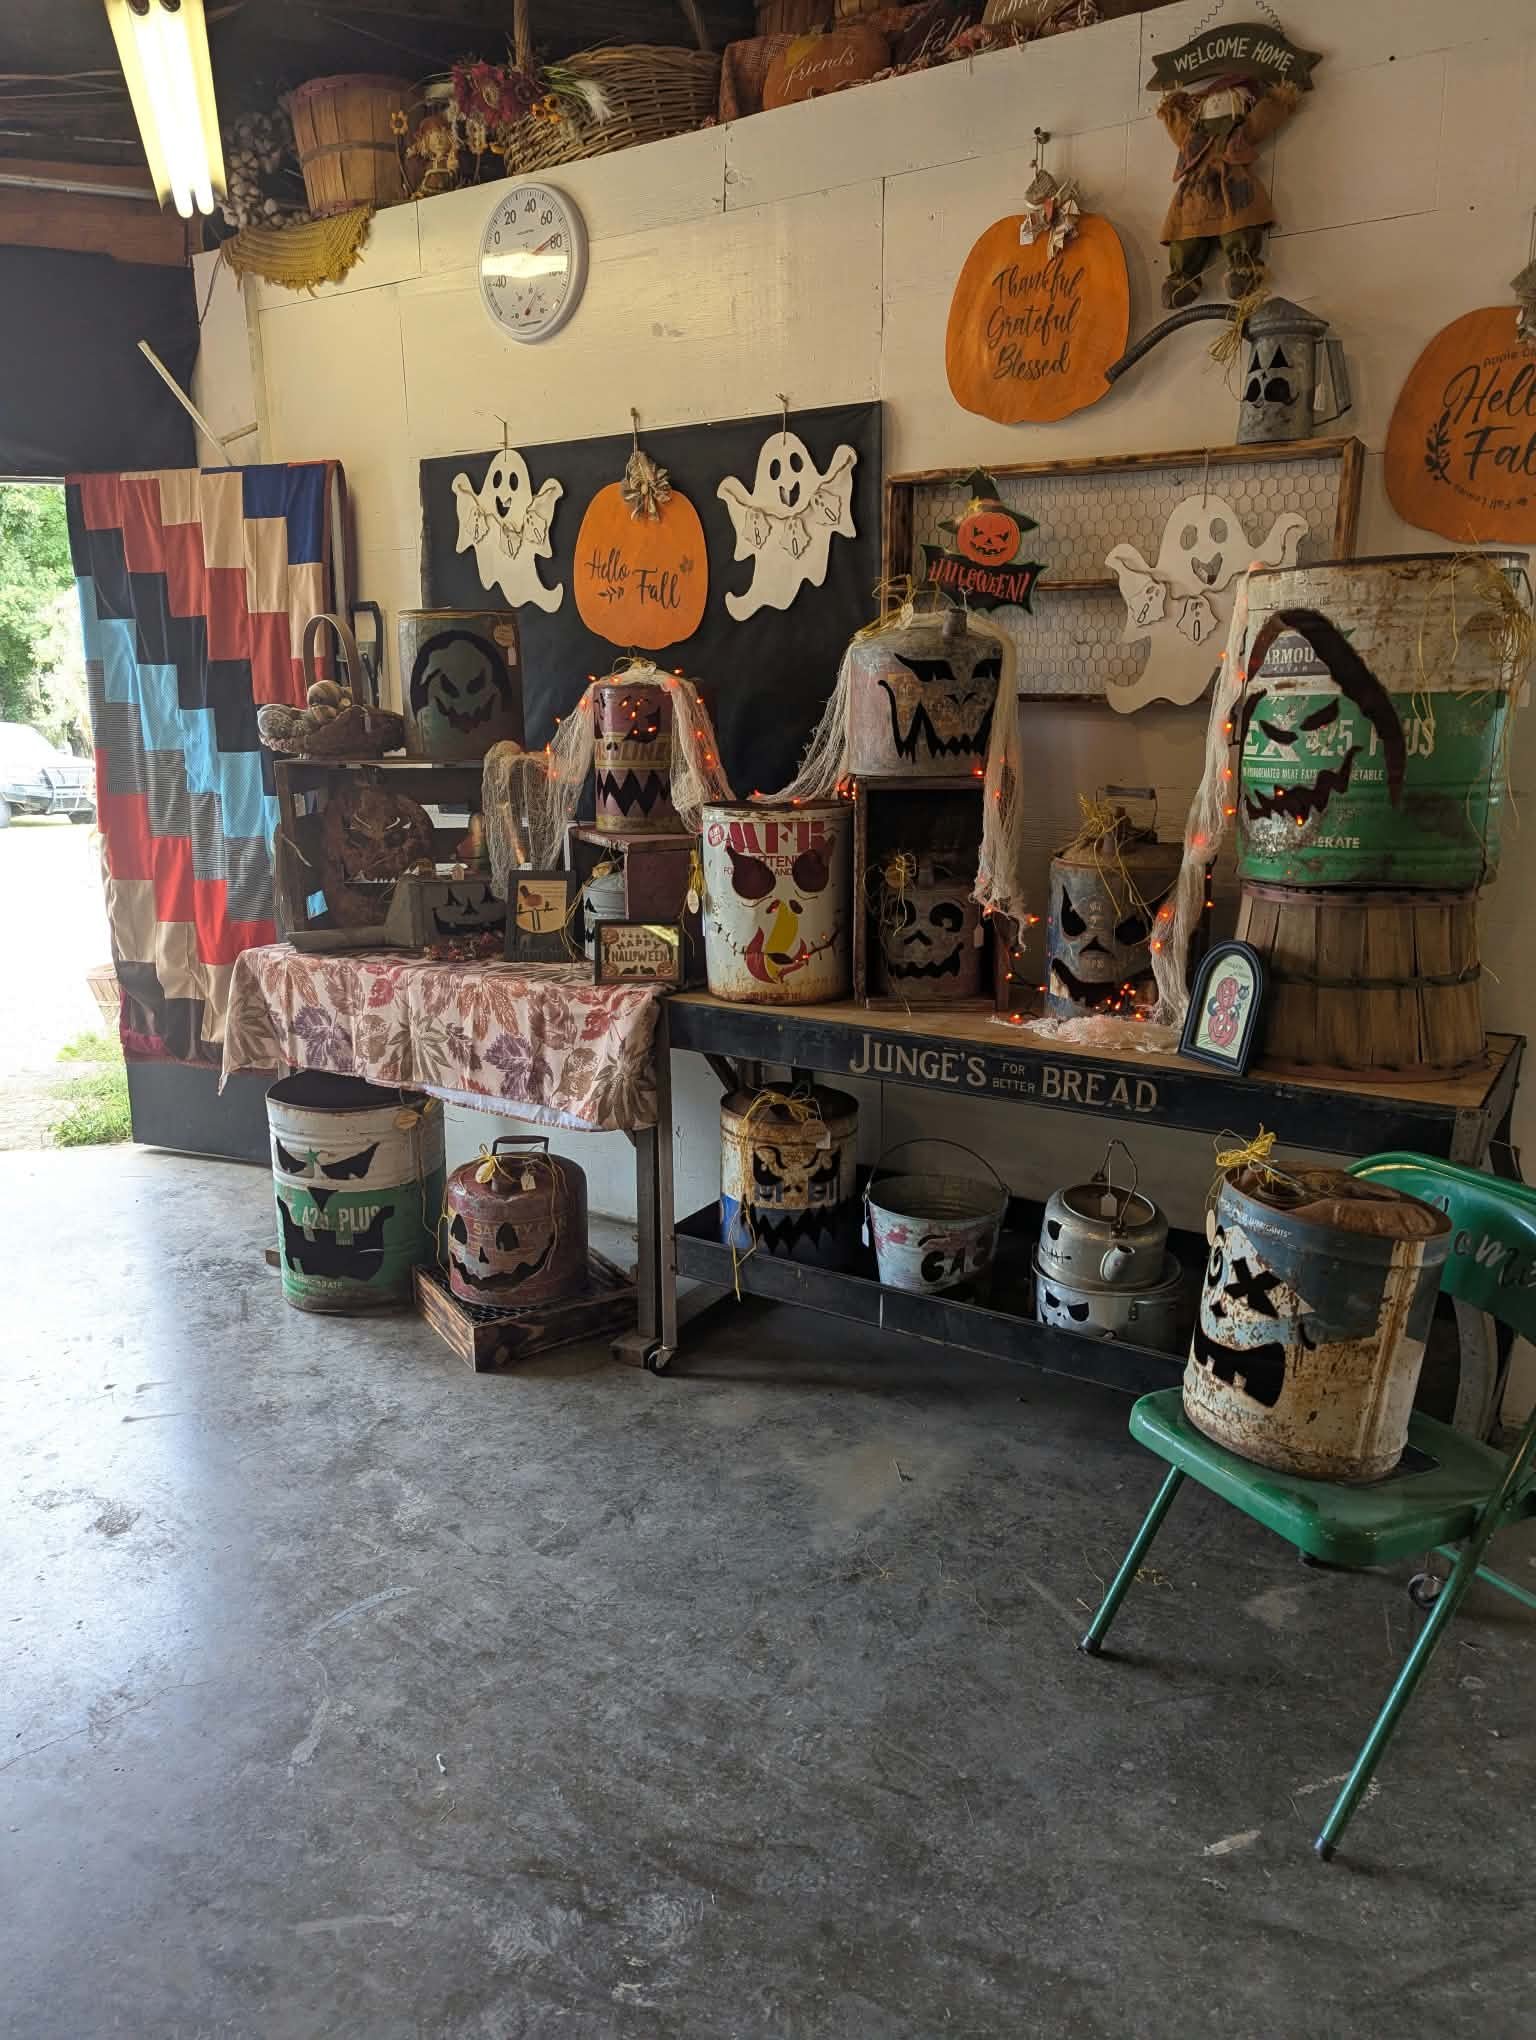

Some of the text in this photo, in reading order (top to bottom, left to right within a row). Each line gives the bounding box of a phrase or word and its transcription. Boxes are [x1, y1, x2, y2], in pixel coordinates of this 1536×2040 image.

[784, 49, 857, 96] friends
[1174, 37, 1295, 72] WELCOME HOME
[504, 209, 517, 225] 20
[524, 198, 537, 214] 40
[540, 209, 553, 226] 60
[494, 230, 501, 245] 0
[549, 233, 563, 249] 80
[992, 247, 1084, 303] Thankful
[987, 297, 1081, 350] Grateful
[994, 341, 1071, 380] Blessed
[1443, 363, 1536, 425] Hell
[1464, 425, 1536, 481] Fal
[584, 547, 630, 584] Hello
[632, 567, 681, 609] Fall
[616, 939, 662, 950] HAPPY
[850, 1034, 1159, 1113] JUNGE'S FOR BETTER BREAD
